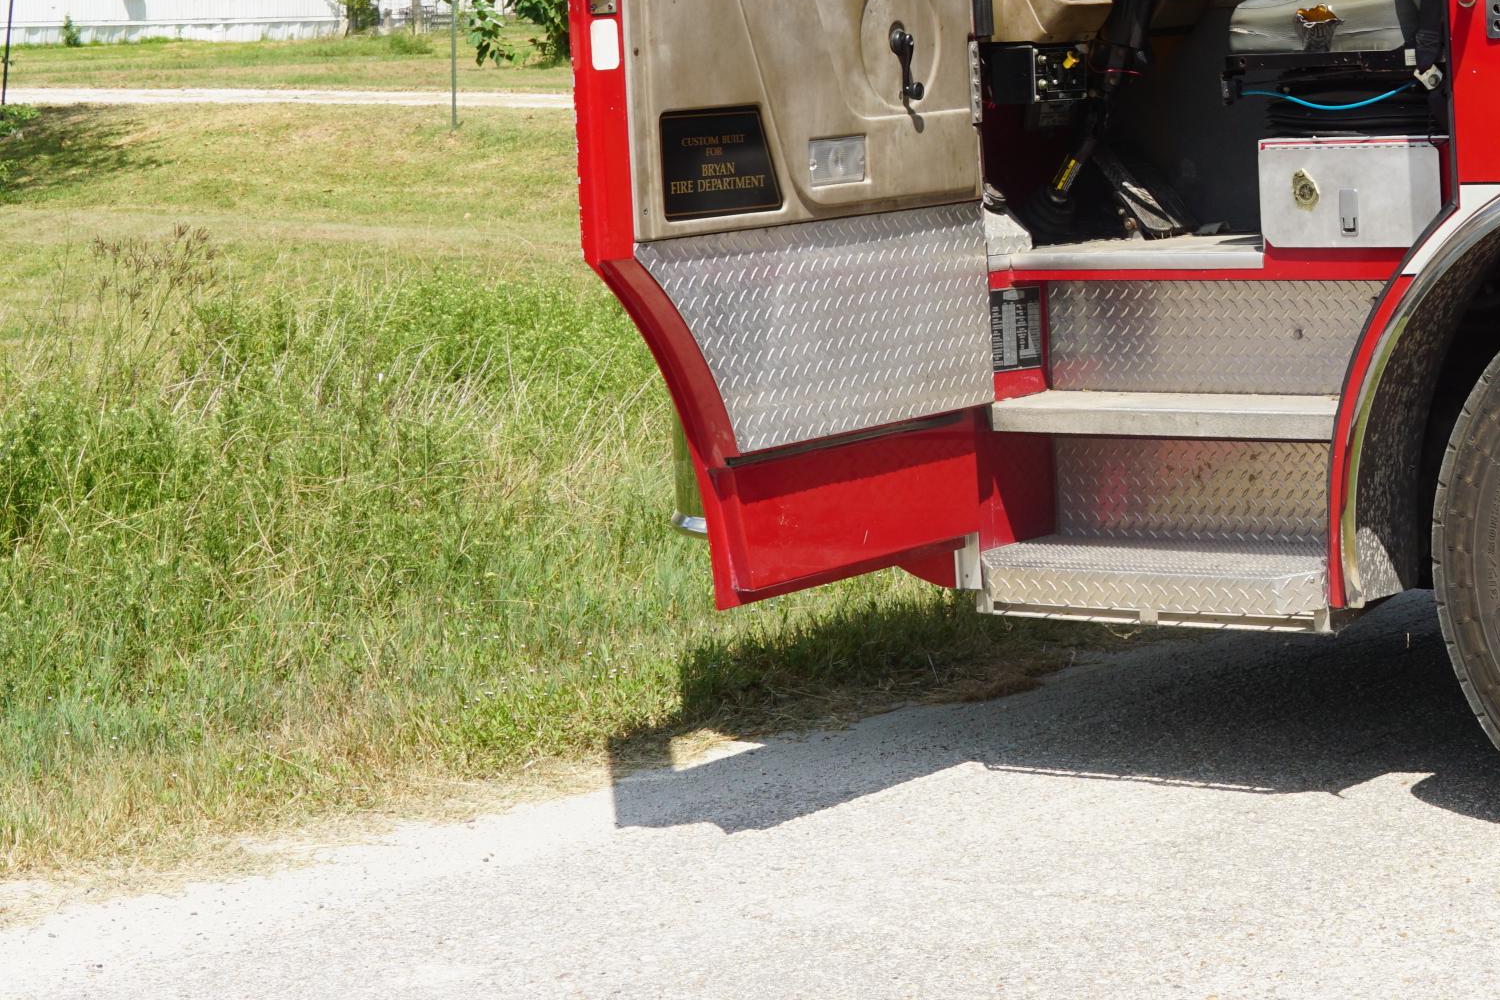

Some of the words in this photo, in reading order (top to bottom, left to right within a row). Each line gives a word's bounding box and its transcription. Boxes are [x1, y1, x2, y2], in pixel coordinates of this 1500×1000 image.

[681, 136, 718, 147] CUSTOM
[722, 134, 745, 144] BUILT
[705, 147, 722, 157] FOR
[702, 162, 735, 176] BRYAN
[671, 181, 694, 194] FIRE
[698, 175, 766, 192] DEPARTMENT
